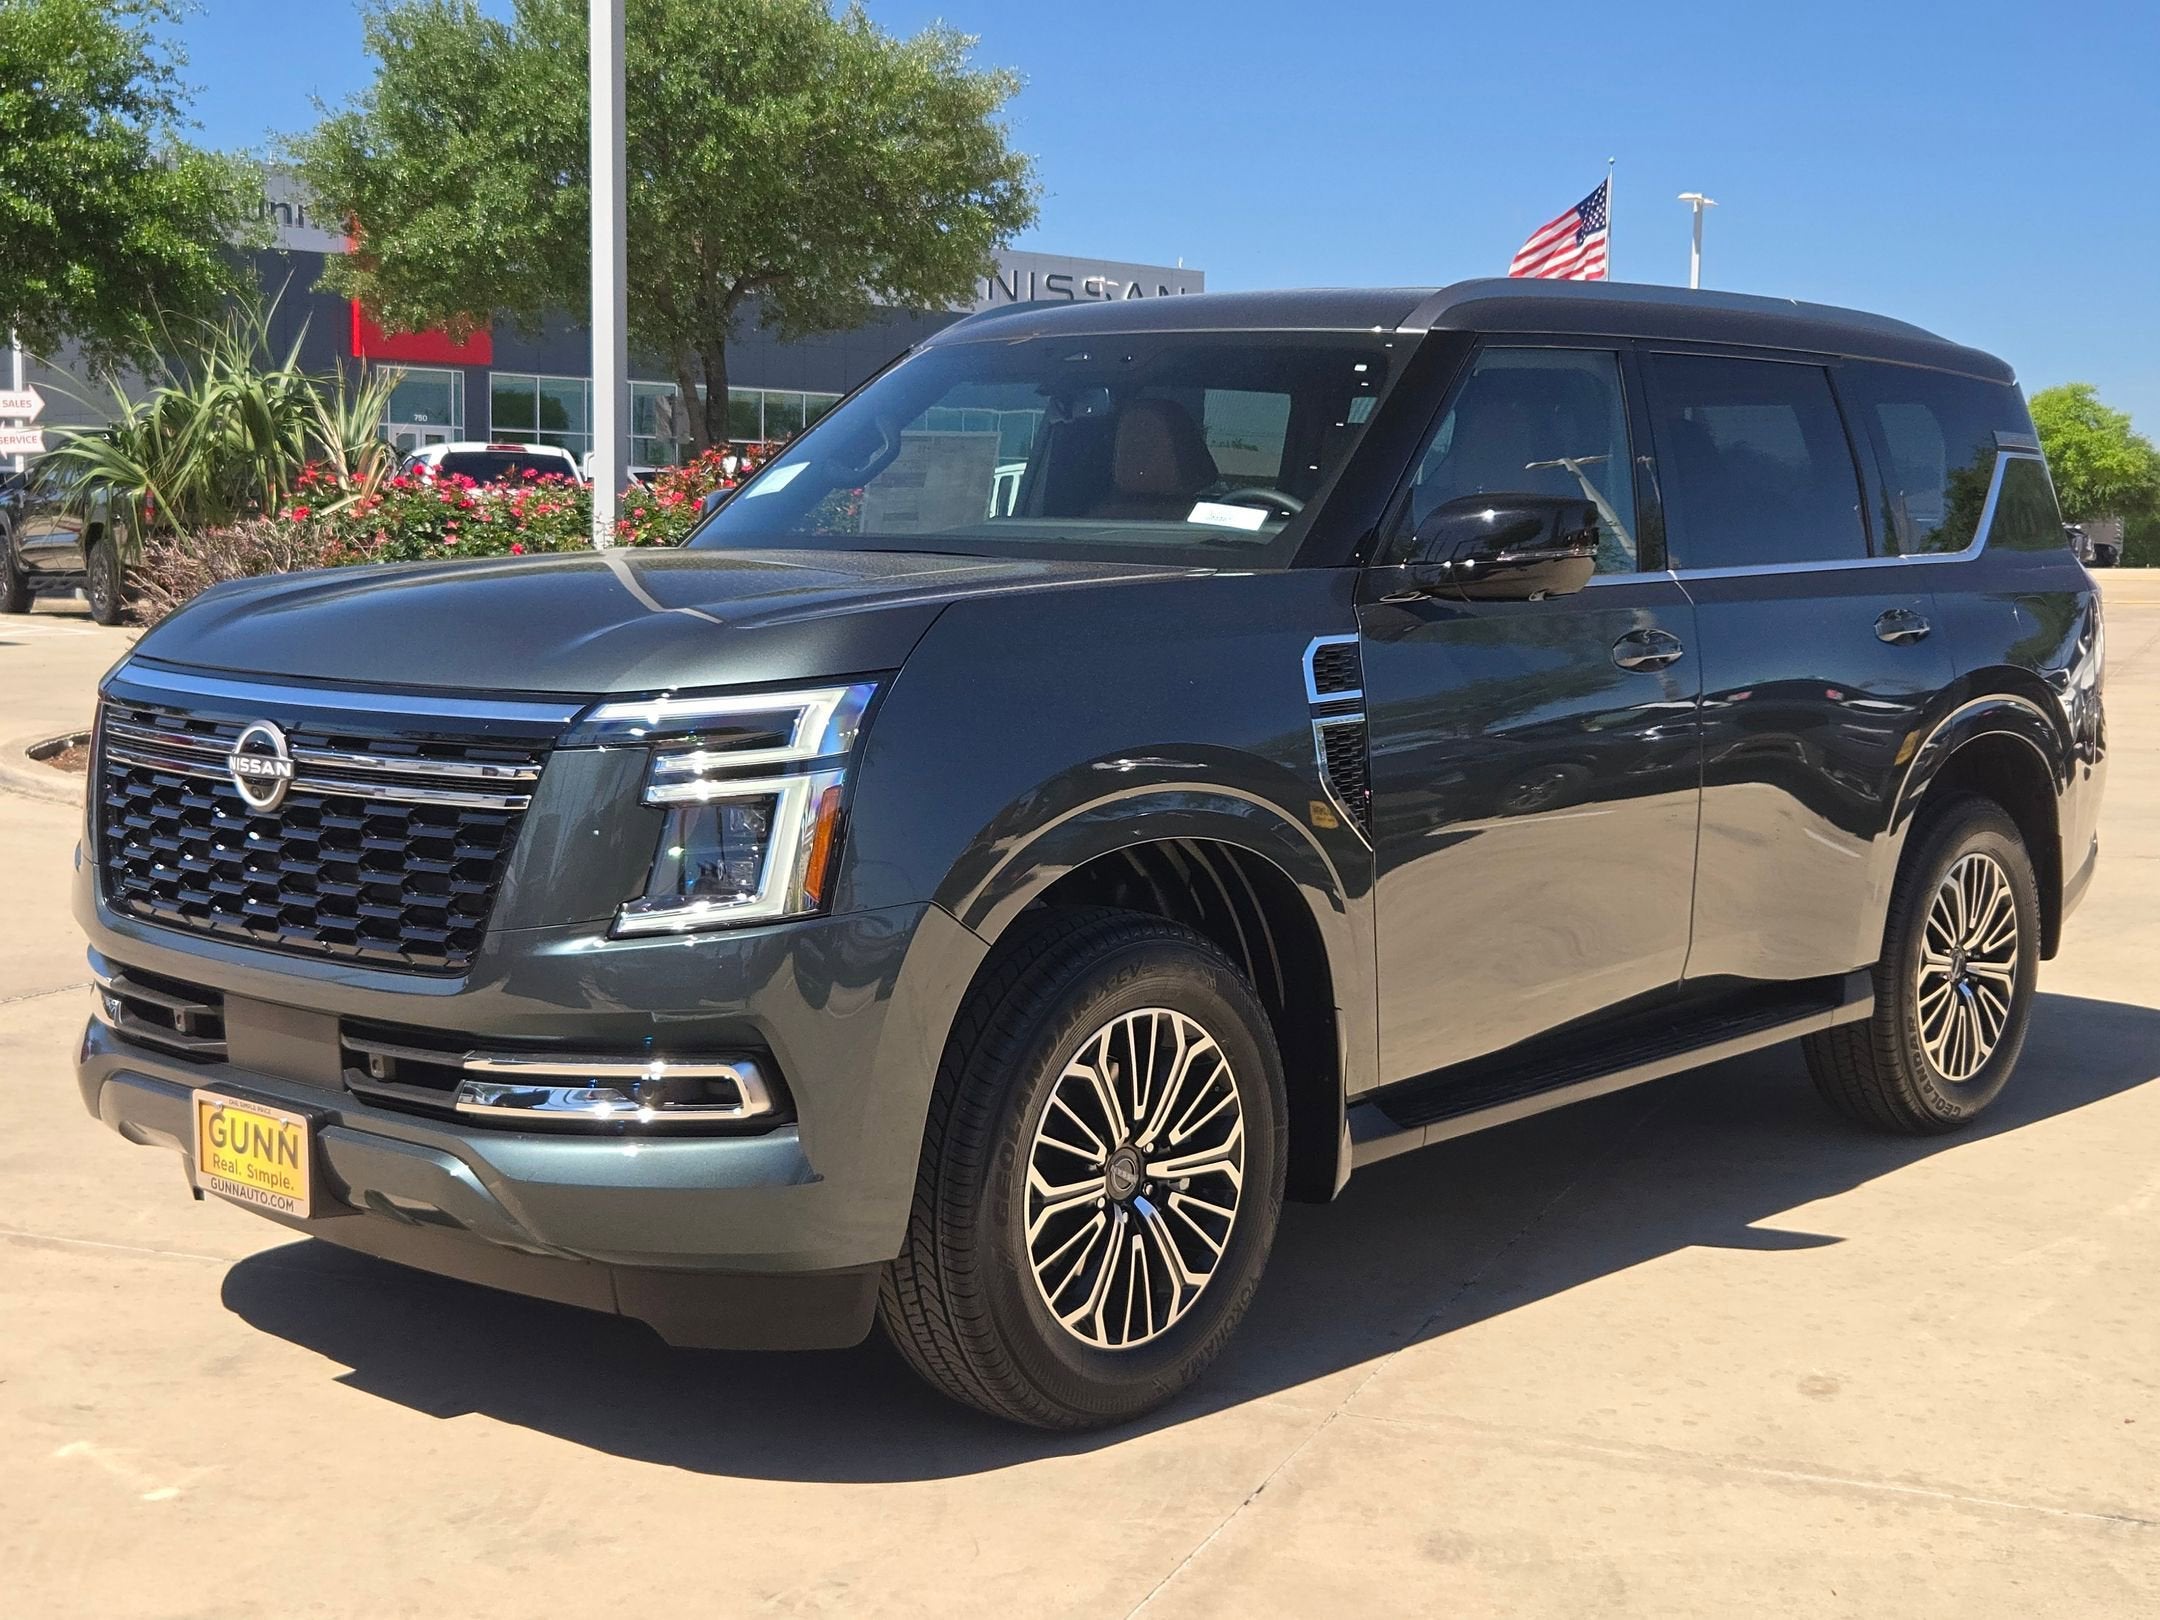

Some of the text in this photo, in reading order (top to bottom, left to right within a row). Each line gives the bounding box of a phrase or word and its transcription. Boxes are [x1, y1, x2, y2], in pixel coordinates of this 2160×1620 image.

[2, 399, 32, 408] SALES
[413, 414, 428, 422] 750
[229, 755, 292, 777] NISSAN
[208, 1111, 299, 1170] GUNN
[213, 1153, 295, 1192] Real. Simple.
[210, 1177, 294, 1212] GUNNAUTO.COM
